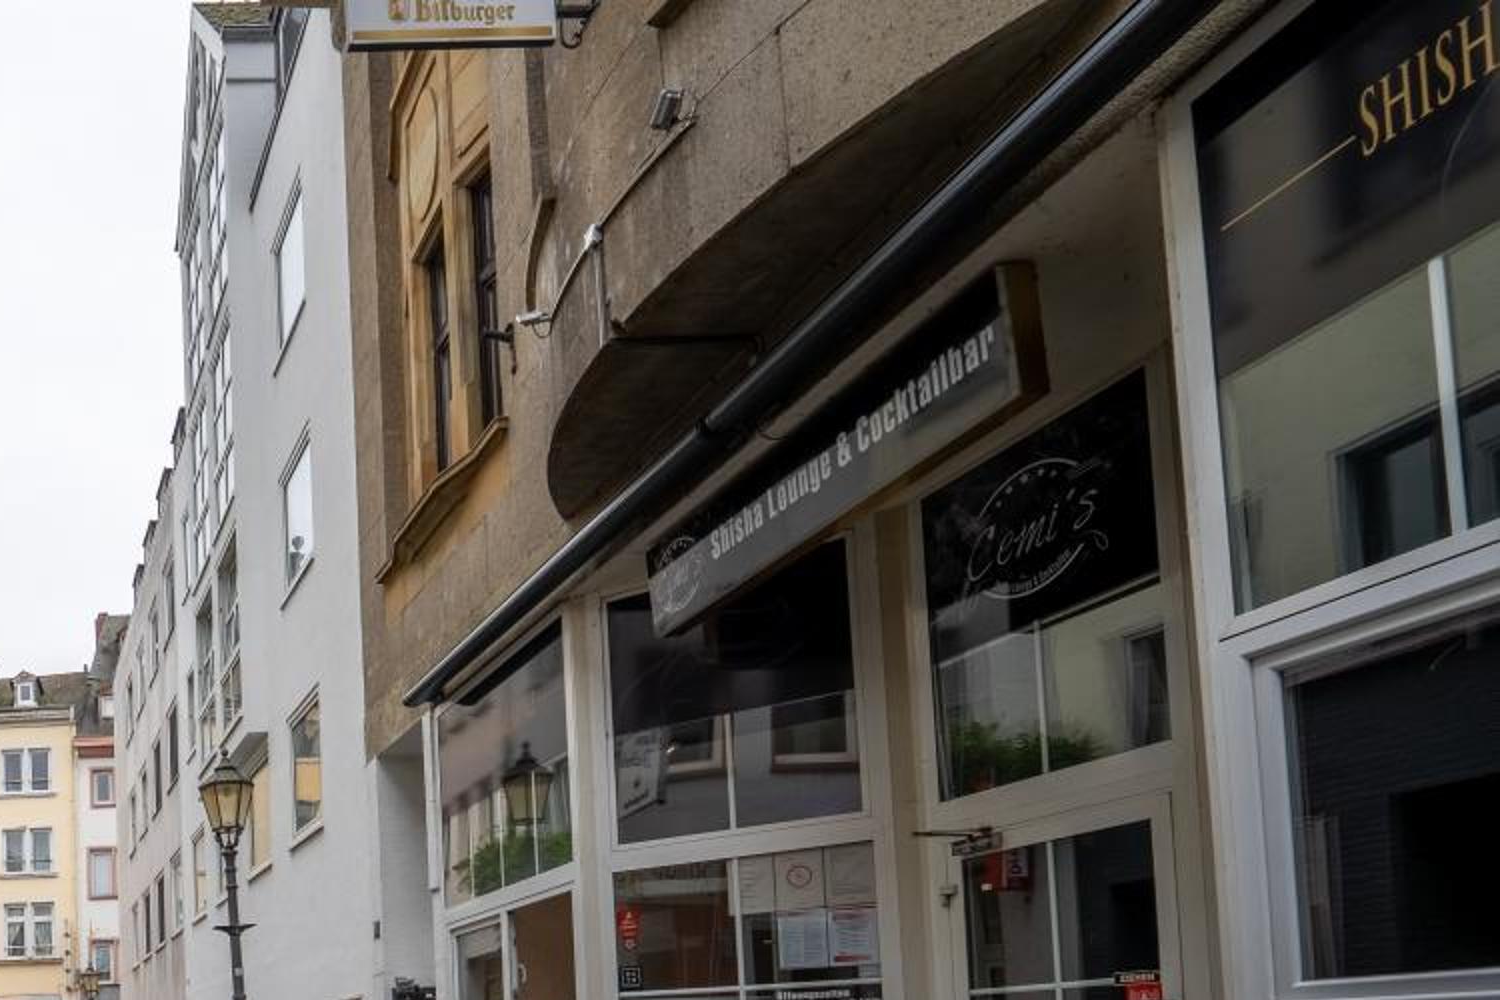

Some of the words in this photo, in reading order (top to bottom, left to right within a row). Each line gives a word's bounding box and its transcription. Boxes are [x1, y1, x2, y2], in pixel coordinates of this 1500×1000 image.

[415, 0, 516, 25] Bitburger
[1359, 0, 1500, 157] SHISH
[710, 500, 764, 560] Shisha
[767, 452, 833, 519] Lounge
[836, 431, 853, 467] &
[855, 325, 996, 453] Cocktailbar
